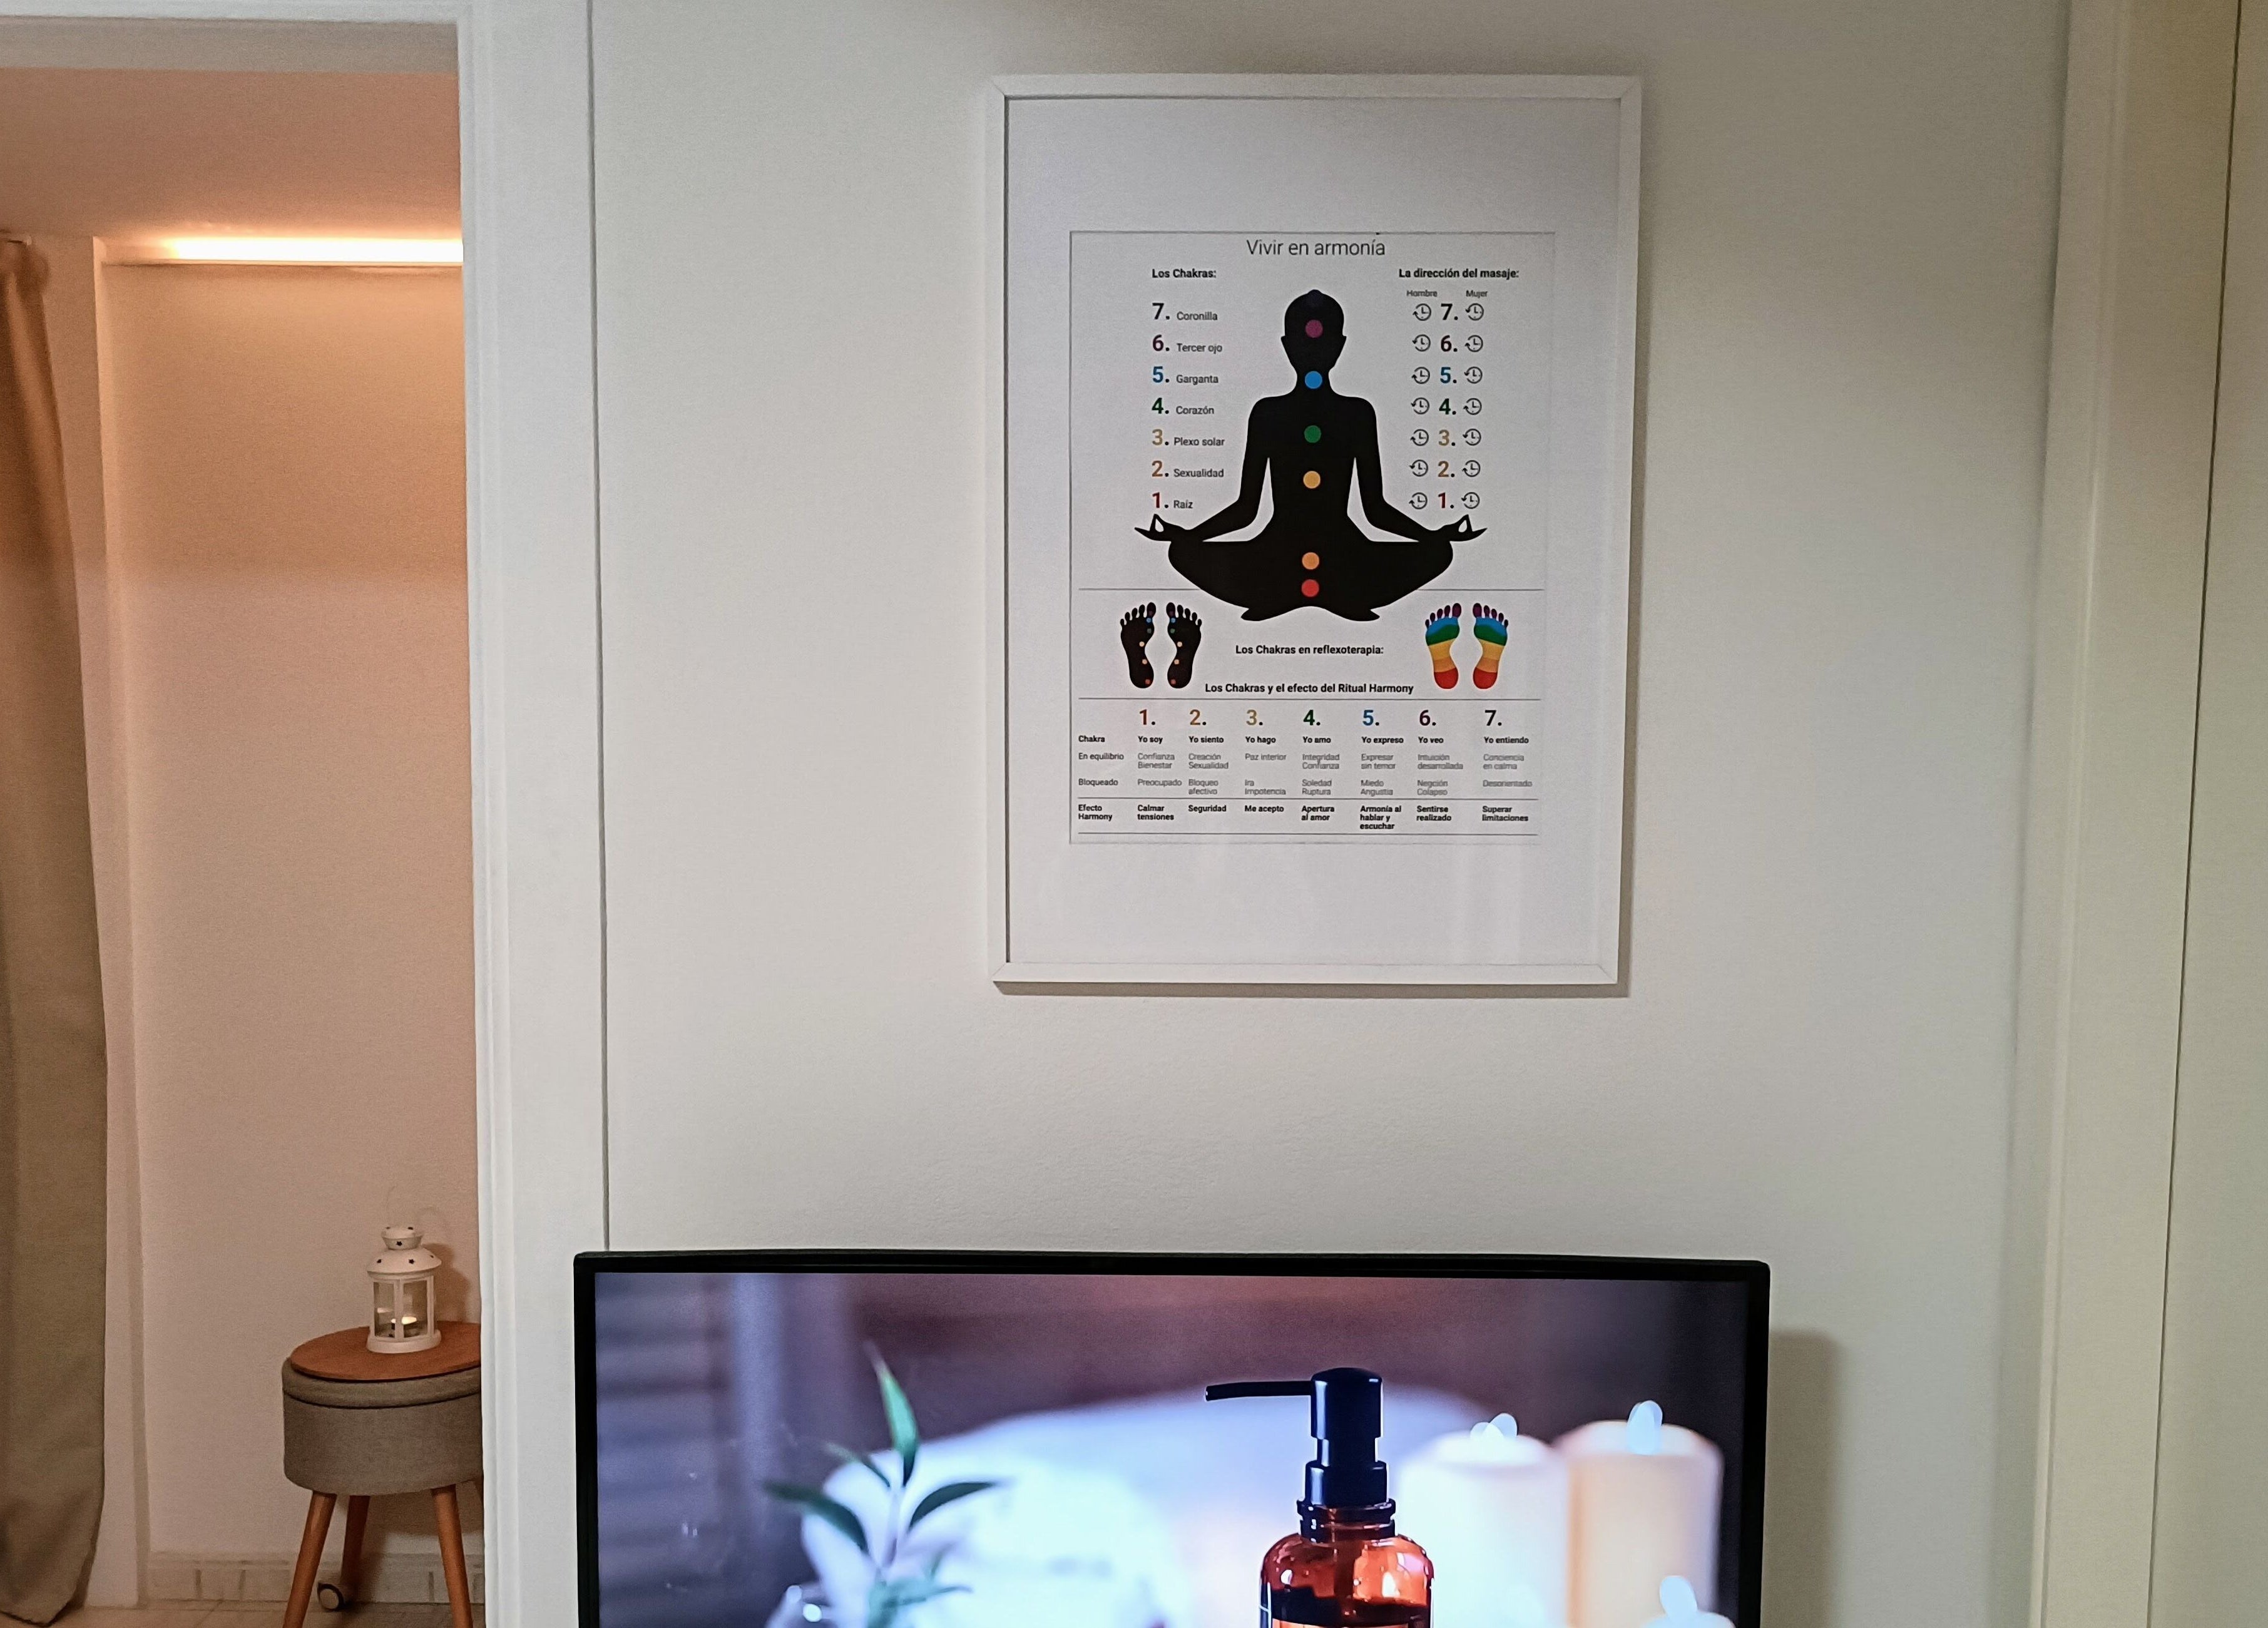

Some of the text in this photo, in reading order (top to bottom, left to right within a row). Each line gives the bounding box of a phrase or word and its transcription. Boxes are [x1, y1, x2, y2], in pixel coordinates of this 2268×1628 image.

[1247, 238, 1386, 255] Vivir en armonía
[1152, 268, 1217, 279] Los Chakras:
[1399, 268, 1520, 280] La dirección del masaje:
[1406, 289, 1438, 297] Hombre
[1466, 290, 1488, 299] Mujer
[1152, 302, 1218, 321] 7. Coronilla
[1441, 303, 1458, 320] 7.
[1152, 334, 1223, 354] 6. Tercer ojo
[1441, 335, 1458, 352] 6.
[1152, 366, 1219, 385] 5. Garganta
[1440, 367, 1457, 384] 5.
[1152, 397, 1214, 415] 4. Corazón
[1439, 398, 1456, 415] 4.
[1152, 429, 1225, 447] 3. Plexo solar
[1438, 429, 1456, 446] 3.
[1152, 461, 1224, 478] 2. Sexualidad
[1438, 461, 1455, 478] 2.
[1152, 492, 1193, 509] 1. Raíz
[1438, 492, 1454, 509] 1.
[1235, 645, 1254, 654] Los
[1255, 645, 1296, 655] Chakras
[1313, 645, 1384, 656] reflexoterapia:
[1205, 683, 1414, 695] Los Chakras y el efecto del Ritual Harmony
[1139, 709, 1155, 726] 1.
[1190, 709, 1207, 726] 2.
[1246, 709, 1263, 726] 3.
[1303, 709, 1321, 726] 4.
[1362, 709, 1380, 726] 5.
[1419, 709, 1436, 726] 6.
[1484, 709, 1502, 726] 7.
[1257, 736, 1276, 744] hago
[1090, 752, 1124, 760] equilibrio
[1302, 788, 1331, 796] Ruptura
[1417, 788, 1448, 796] Colapso
[1188, 805, 1227, 813] Seguridad
[1302, 806, 1334, 814] Apertura
[1483, 806, 1512, 814] Superar
